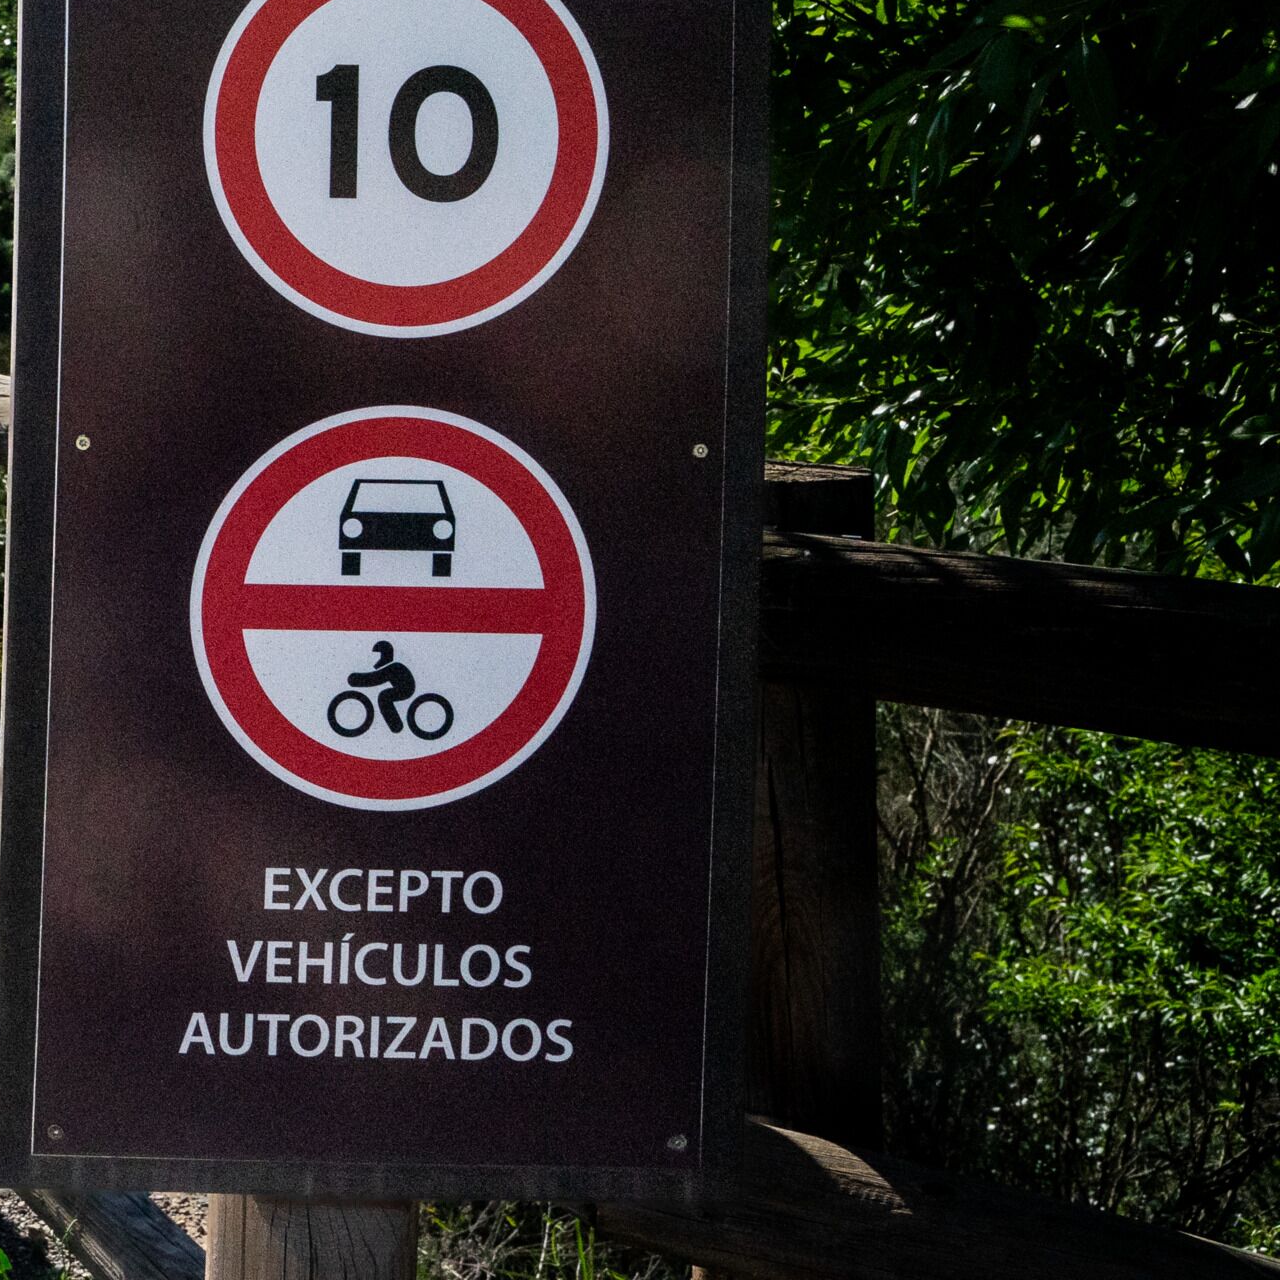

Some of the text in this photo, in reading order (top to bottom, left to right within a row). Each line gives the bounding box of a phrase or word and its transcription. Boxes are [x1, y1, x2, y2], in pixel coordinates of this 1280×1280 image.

[315, 64, 500, 203] 10
[263, 867, 503, 915] EXCEPTO
[226, 932, 532, 988] VEHÍCULOS
[178, 1011, 574, 1063] AUTORIZADOS
